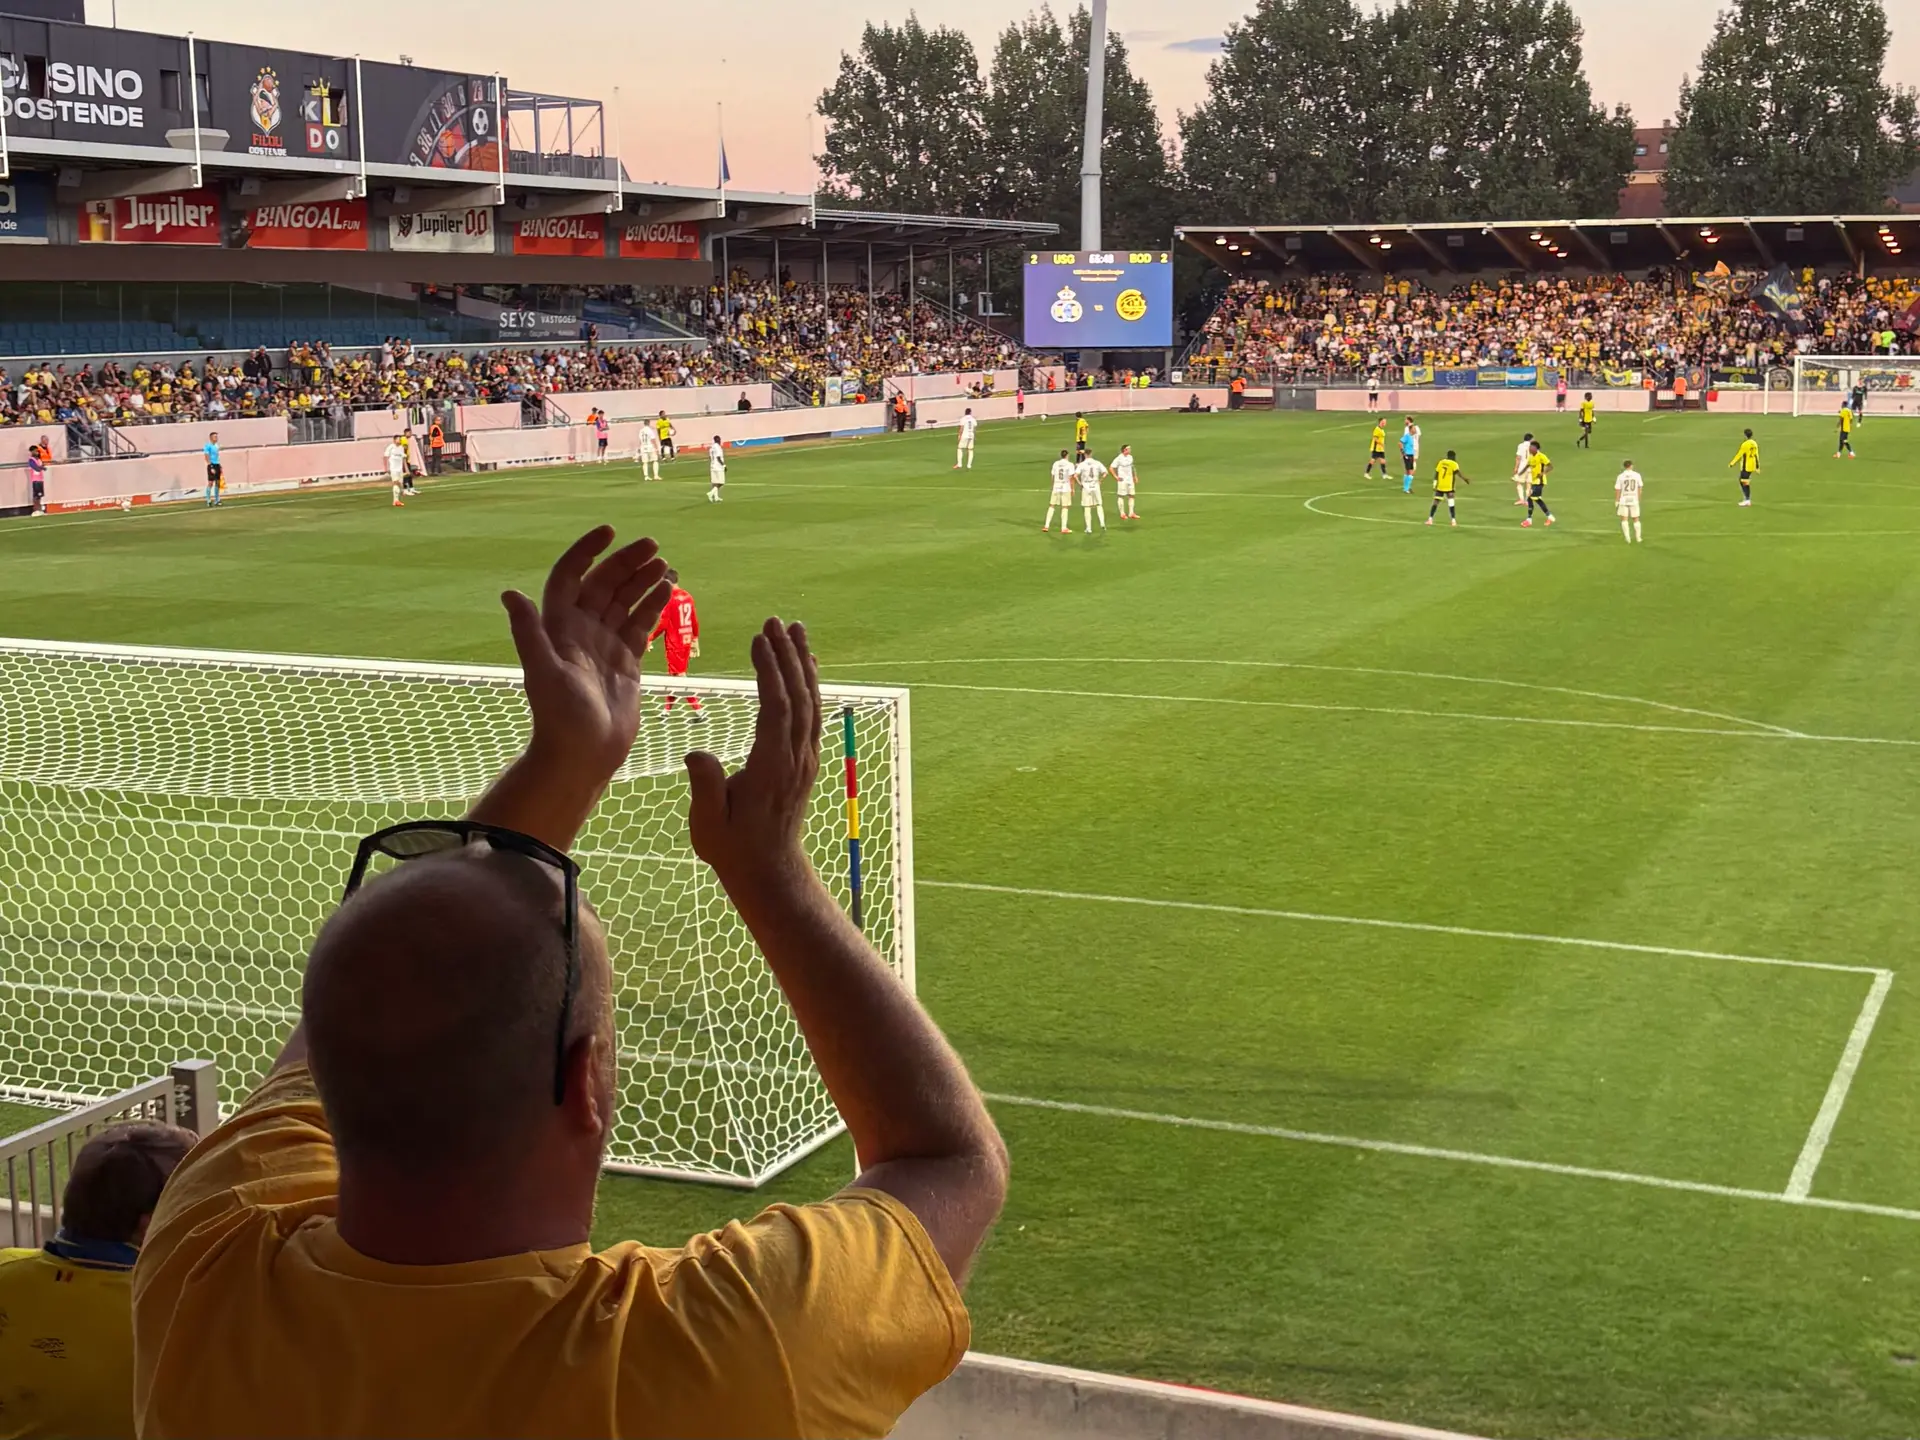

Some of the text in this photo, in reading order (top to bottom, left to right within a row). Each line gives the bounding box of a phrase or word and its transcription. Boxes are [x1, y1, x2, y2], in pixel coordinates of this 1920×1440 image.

[122, 196, 214, 234] Jupiler
[416, 213, 463, 236] Jupiler
[1030, 254, 1038, 264] 2
[1160, 253, 1168, 263] 2
[499, 312, 536, 328] SEYS
[1623, 479, 1636, 491] 20
[678, 602, 692, 627] 12
